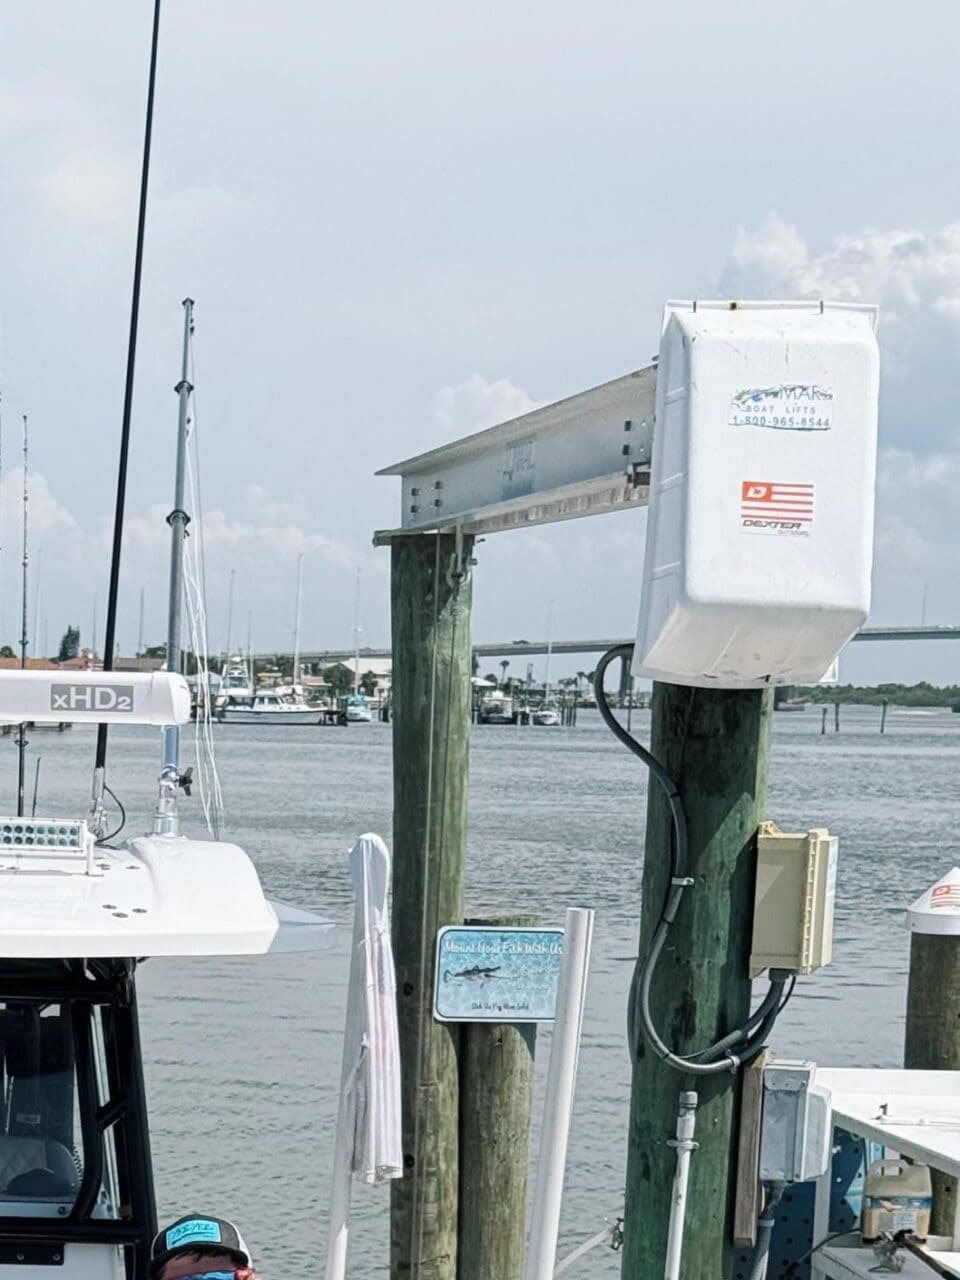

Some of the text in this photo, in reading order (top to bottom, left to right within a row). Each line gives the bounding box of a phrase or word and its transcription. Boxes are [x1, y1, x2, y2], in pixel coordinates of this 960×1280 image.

[785, 406, 816, 415] LIFTS
[742, 519, 802, 529] DEXTER
[52, 686, 132, 710] xHD2
